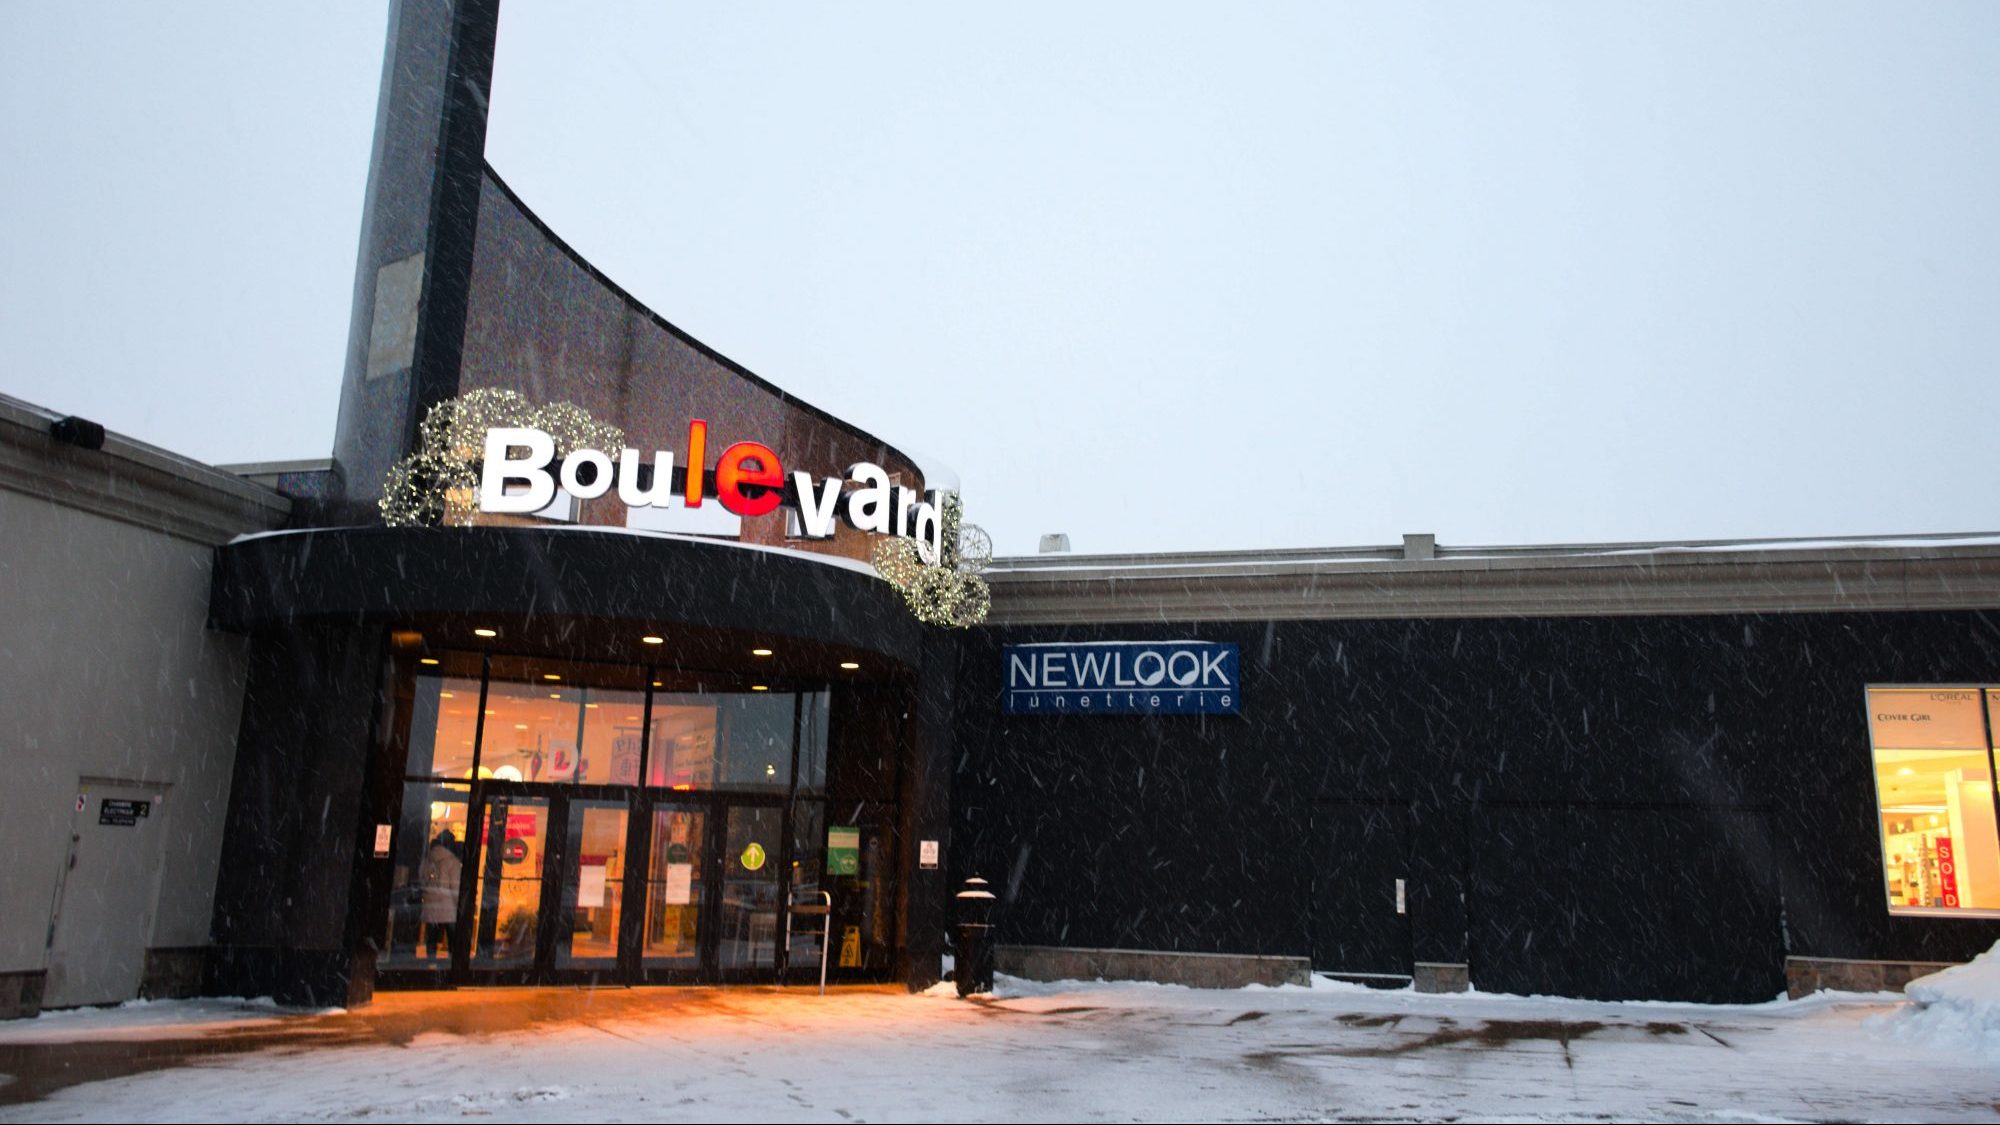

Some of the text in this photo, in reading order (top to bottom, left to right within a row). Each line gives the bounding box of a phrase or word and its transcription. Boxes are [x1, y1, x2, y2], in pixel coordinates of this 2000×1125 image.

[479, 418, 943, 568] Boulevard
[1010, 650, 1230, 687] NEWLOOK
[1010, 692, 1231, 708] lunetterie
[140, 803, 147, 816] 2
